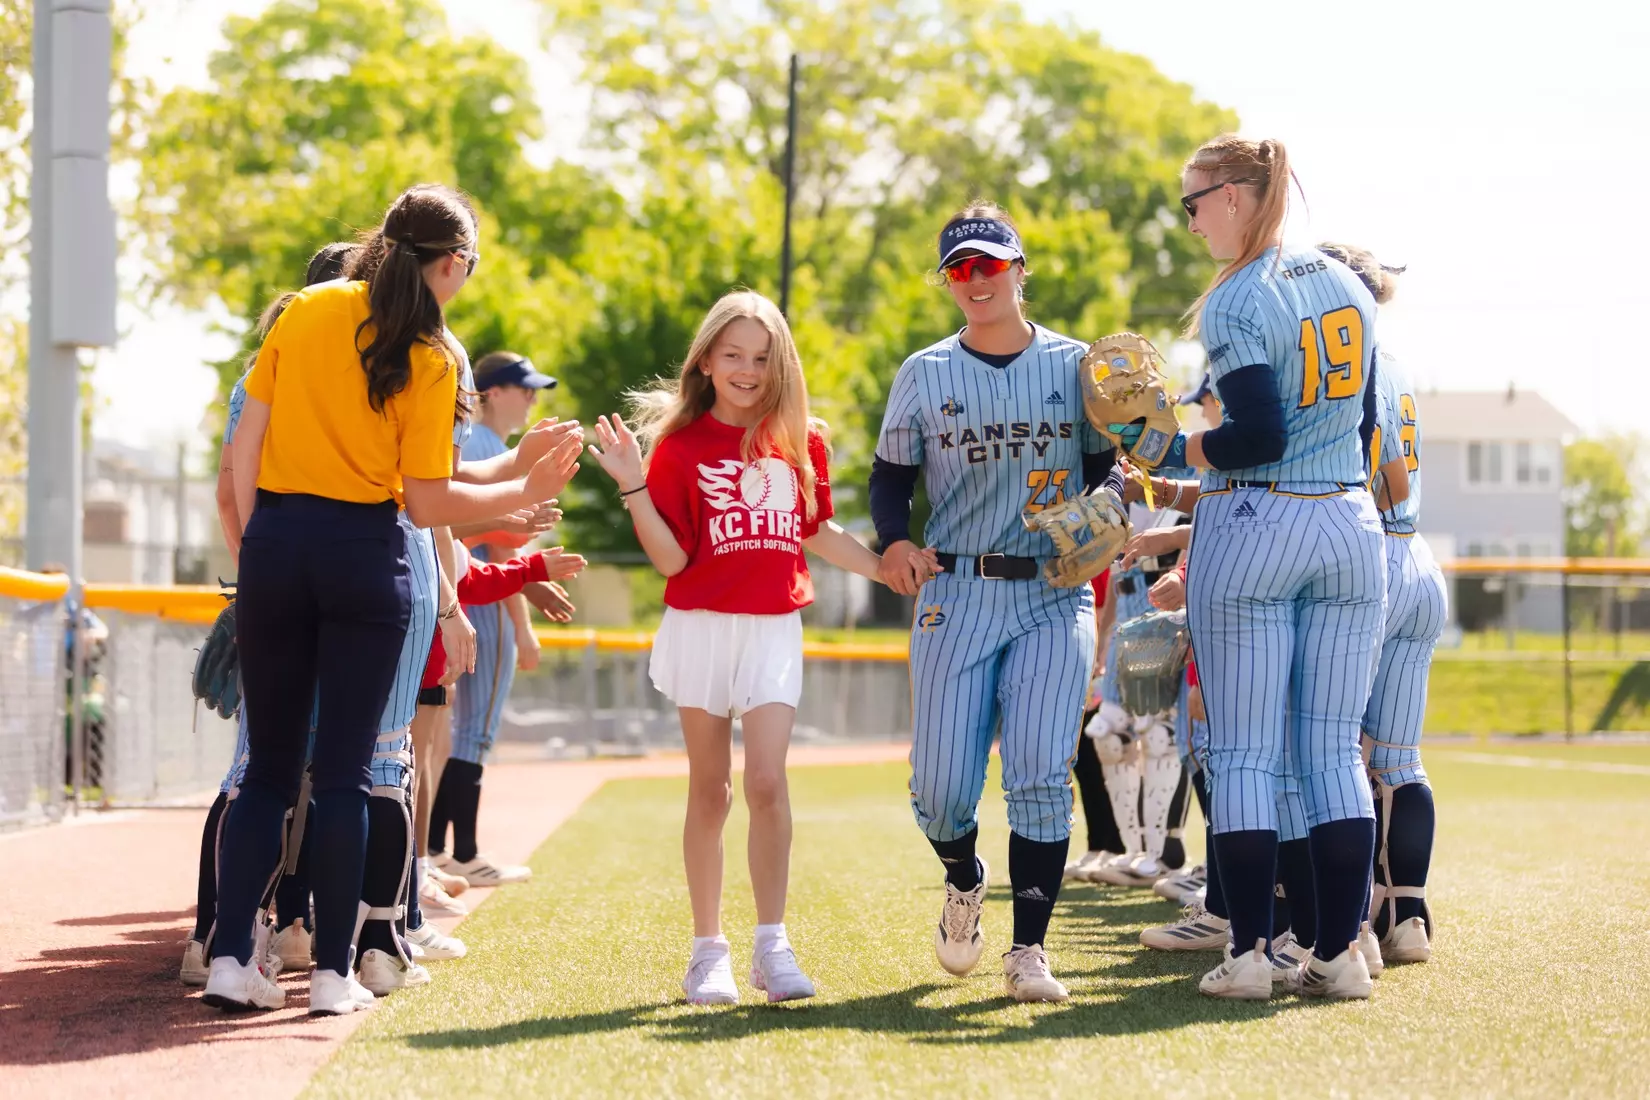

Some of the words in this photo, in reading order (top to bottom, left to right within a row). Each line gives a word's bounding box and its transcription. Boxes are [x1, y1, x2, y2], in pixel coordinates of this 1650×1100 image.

[948, 222, 996, 237] KANSAS
[957, 227, 985, 238] CITY
[1281, 259, 1328, 280] ROOS
[1298, 305, 1363, 409] 19
[938, 422, 1073, 449] KANSAS
[967, 441, 1050, 463] CITY
[709, 511, 743, 546] KC
[750, 510, 802, 542] FIRE
[763, 539, 798, 555] SOFTBALL
[1017, 891, 1049, 902] adidas
